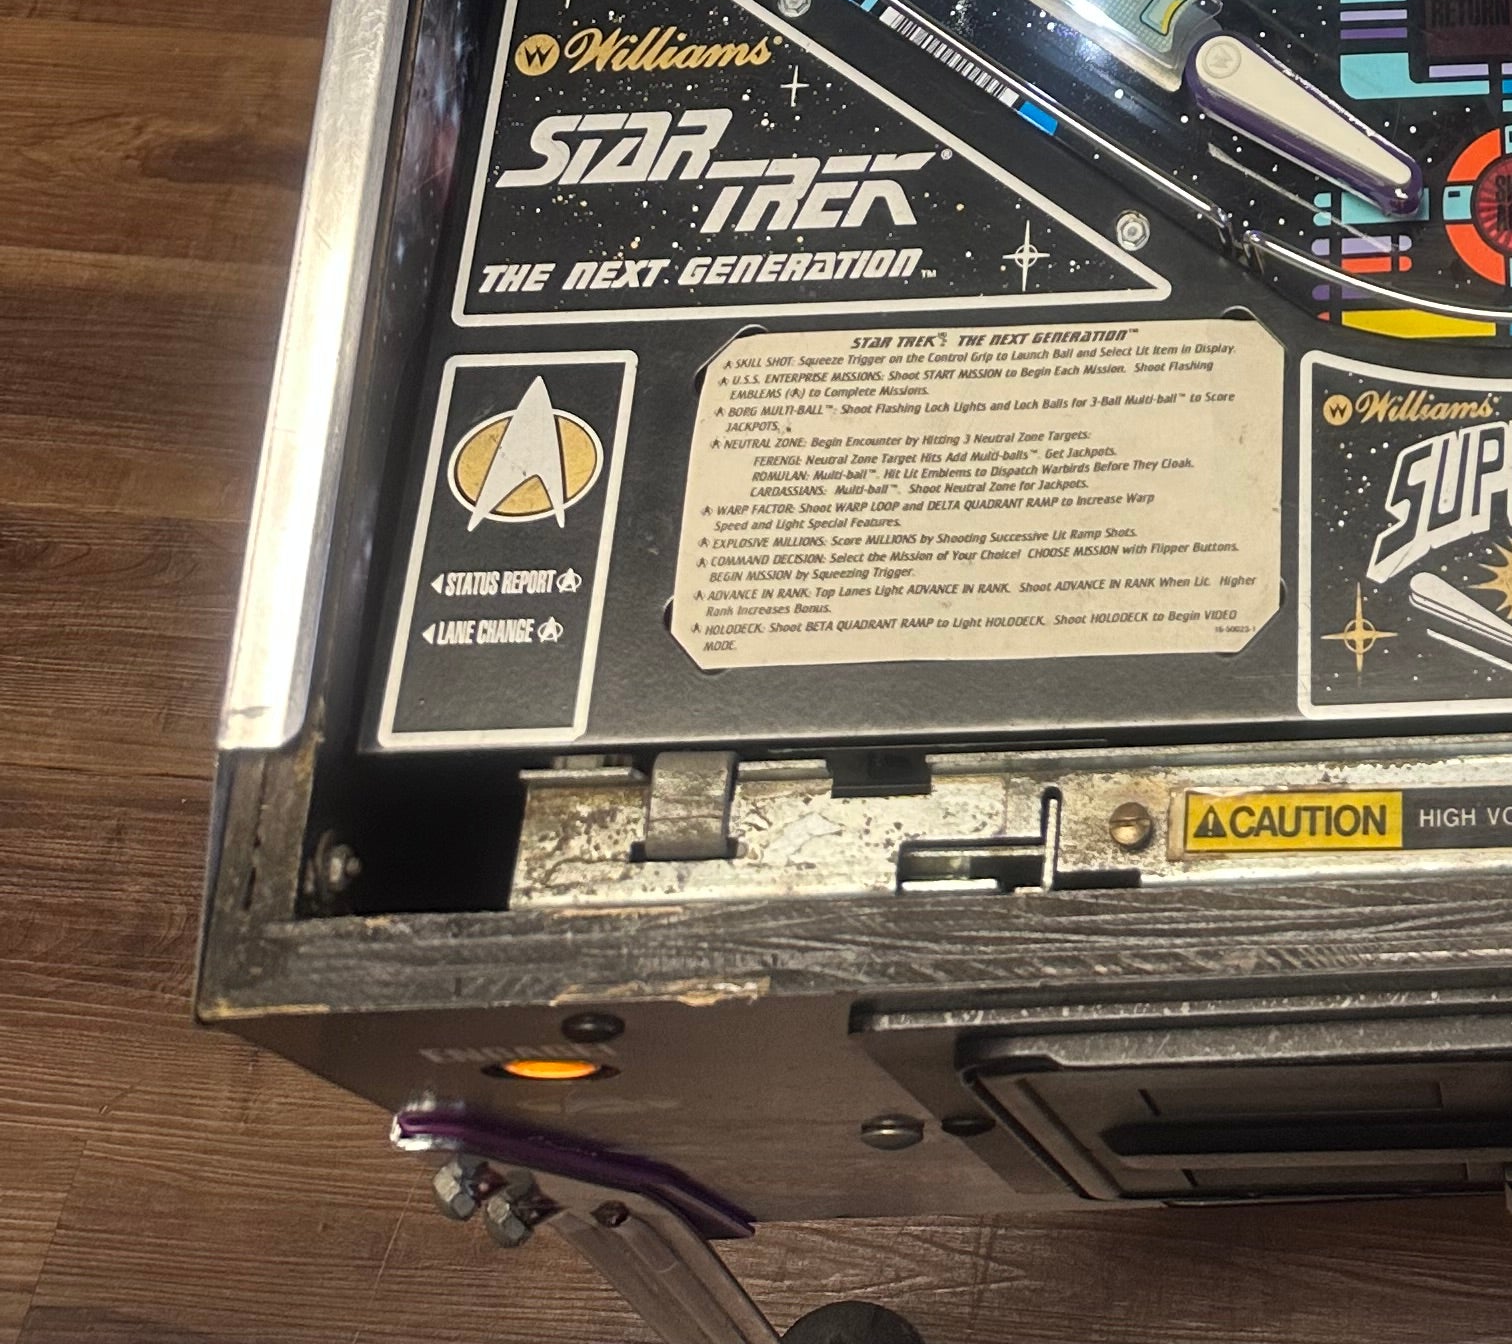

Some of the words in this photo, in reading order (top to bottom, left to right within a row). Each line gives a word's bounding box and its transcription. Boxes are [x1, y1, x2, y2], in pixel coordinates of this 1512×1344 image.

[564, 28, 772, 74] Williams
[496, 108, 733, 188] STAR
[700, 150, 940, 233] TREK
[479, 263, 554, 293] THE
[571, 256, 666, 289] NEXT
[679, 248, 924, 284] GENERATION
[850, 337, 890, 348] STAR
[897, 336, 935, 347] TREK
[957, 335, 986, 348] THE
[989, 333, 1030, 345] NEXT
[735, 358, 762, 369] SKILL
[800, 355, 844, 368] Squeeze
[848, 354, 886, 367] Trigger
[889, 355, 902, 363] on
[906, 353, 924, 363] the
[928, 352, 967, 363] Control
[971, 351, 993, 363] Grip
[996, 351, 1008, 361] to
[1011, 350, 1049, 361] Launch
[1052, 349, 1073, 359] Ball
[1076, 347, 1097, 358] and
[1099, 346, 1132, 357] Select
[1136, 346, 1150, 356] Lit
[1153, 345, 1178, 355] Item
[1181, 345, 1192, 354] in
[1195, 343, 1236, 355] Display.
[764, 372, 827, 384] ENTERPRISE
[888, 369, 920, 381] Shoot
[923, 369, 955, 380] START
[957, 368, 1002, 380] MISSION
[730, 389, 782, 400] EMBLEMS
[1355, 391, 1495, 424] Williams
[728, 406, 758, 417] BORG
[711, 555, 769, 567] COMMAND
[445, 569, 500, 597] STATUS
[502, 568, 555, 594] REPORT
[436, 619, 475, 645] LANE
[477, 617, 535, 644] CHANGE
[1229, 804, 1388, 839] CAUTION
[1418, 806, 1478, 829] HIGH
